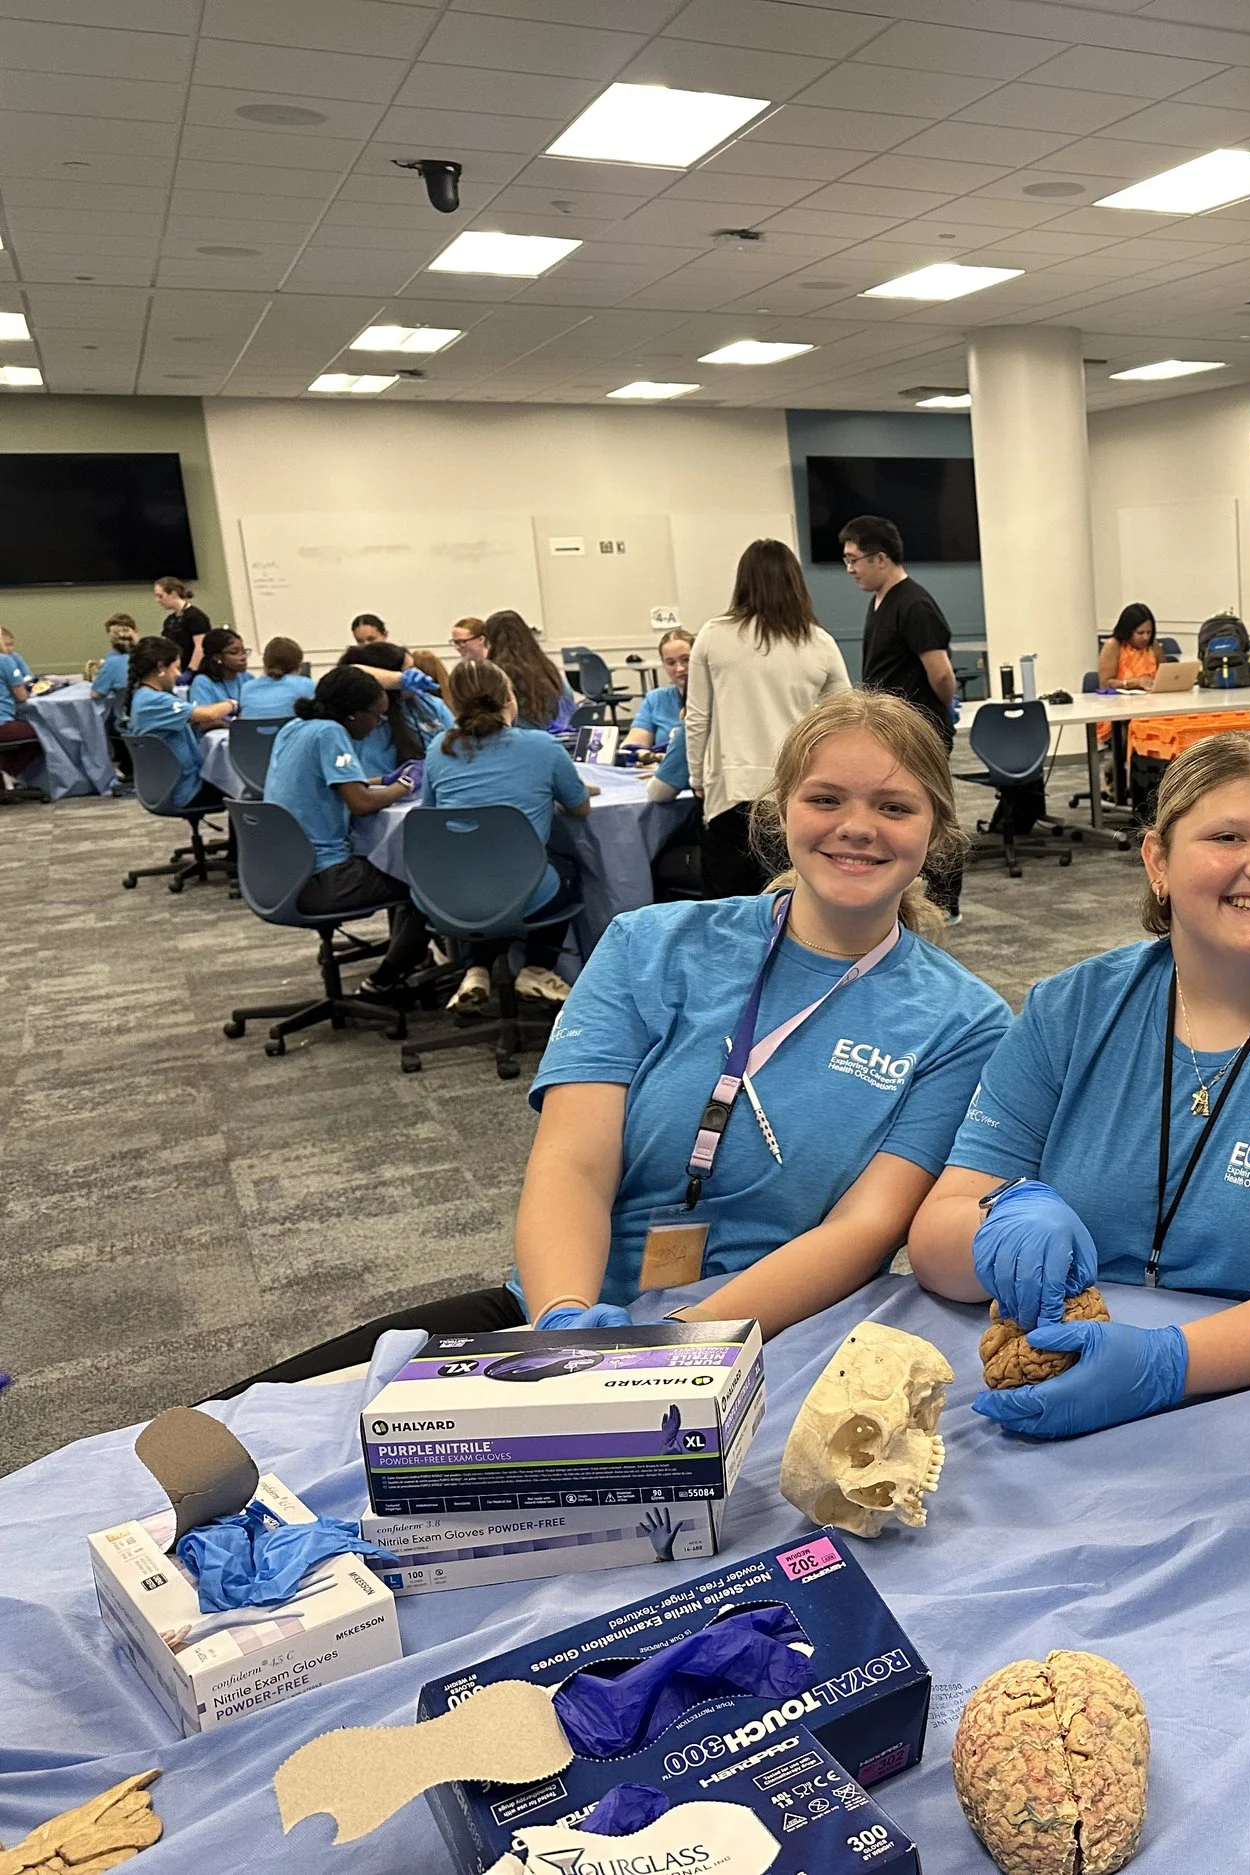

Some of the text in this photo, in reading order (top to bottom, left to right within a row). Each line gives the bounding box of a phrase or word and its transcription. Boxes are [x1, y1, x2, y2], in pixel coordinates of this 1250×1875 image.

[832, 1038, 911, 1078] ECHO
[830, 1056, 905, 1085] Exploring Careers in
[828, 1063, 897, 1092] Health Occupations
[445, 1362, 478, 1373] XL
[668, 1359, 722, 1367] PURPLE
[604, 1378, 688, 1387] HALYARD
[392, 1420, 455, 1432] HALYARD
[685, 1436, 705, 1448] XL
[378, 1444, 434, 1457] PURPLE
[379, 1453, 511, 1466] POWDER-FREE EXAM GLOVES
[652, 1489, 662, 1497] 90
[688, 1488, 715, 1497] 55084
[425, 1519, 441, 1528] 3.8
[378, 1516, 566, 1548] Nitrile Exam Gloves POWDER-FREE
[785, 1549, 811, 1561] MEDIUM
[788, 1555, 819, 1575] 302
[389, 1575, 398, 1584] L
[407, 1570, 424, 1579] 100
[608, 1562, 766, 1630] Powder Free, Finger-Textured
[530, 1571, 772, 1673] Non-Sterile Nitrile Examination Gloves
[286, 1650, 295, 1661] C
[213, 1687, 252, 1708] Nitrile
[255, 1670, 290, 1691] Exam
[292, 1649, 339, 1674] Gloves
[443, 1673, 477, 1691] BY WEIGHT
[449, 1681, 476, 1694] GLOVES
[216, 1673, 310, 1721] POWDER-FREE
[763, 1770, 781, 1781] Tested
[799, 1757, 810, 1765] with
[764, 1759, 817, 1786] Chemotherapy drugs
[537, 1791, 556, 1803] Tested
[498, 1801, 515, 1812] drugs
[517, 1803, 528, 1811] use
[777, 1799, 794, 1809] 1.5
[503, 1808, 517, 1817] with
[847, 1824, 888, 1852] 300
[862, 1839, 888, 1854] GLOVES
[862, 1841, 895, 1861] BY WEIGHT
